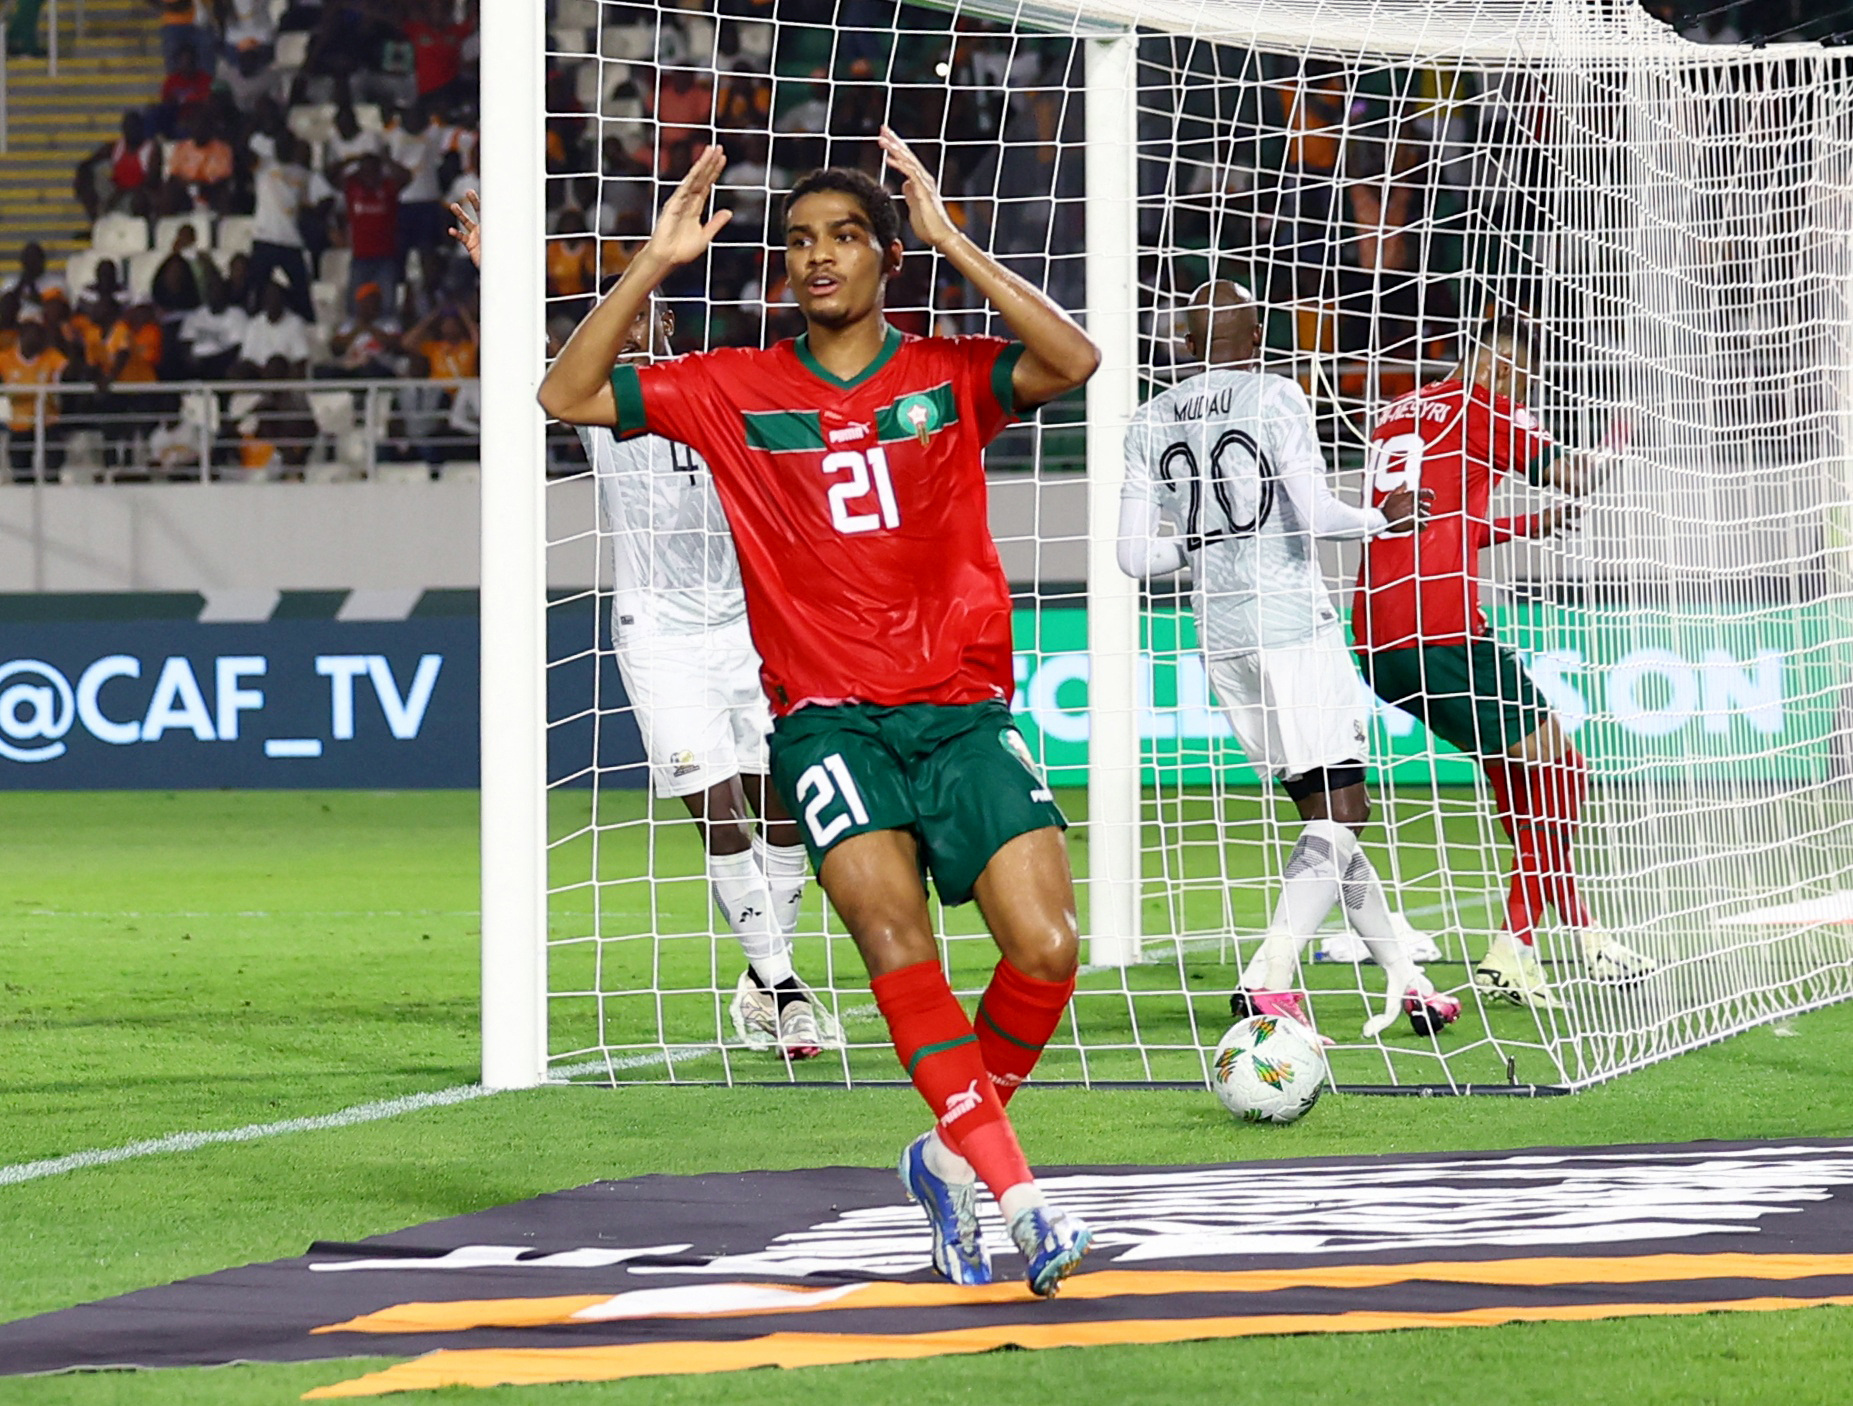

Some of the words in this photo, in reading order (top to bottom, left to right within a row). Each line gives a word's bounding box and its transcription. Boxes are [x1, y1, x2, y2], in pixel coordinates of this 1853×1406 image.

[1173, 387, 1233, 423] MUDAU
[821, 446, 901, 535] 21
[1159, 428, 1274, 552] 20
[1363, 432, 1425, 541] 19
[0, 654, 444, 763] @CAF_TV
[1607, 647, 1786, 738] ON
[795, 752, 870, 847] 21
